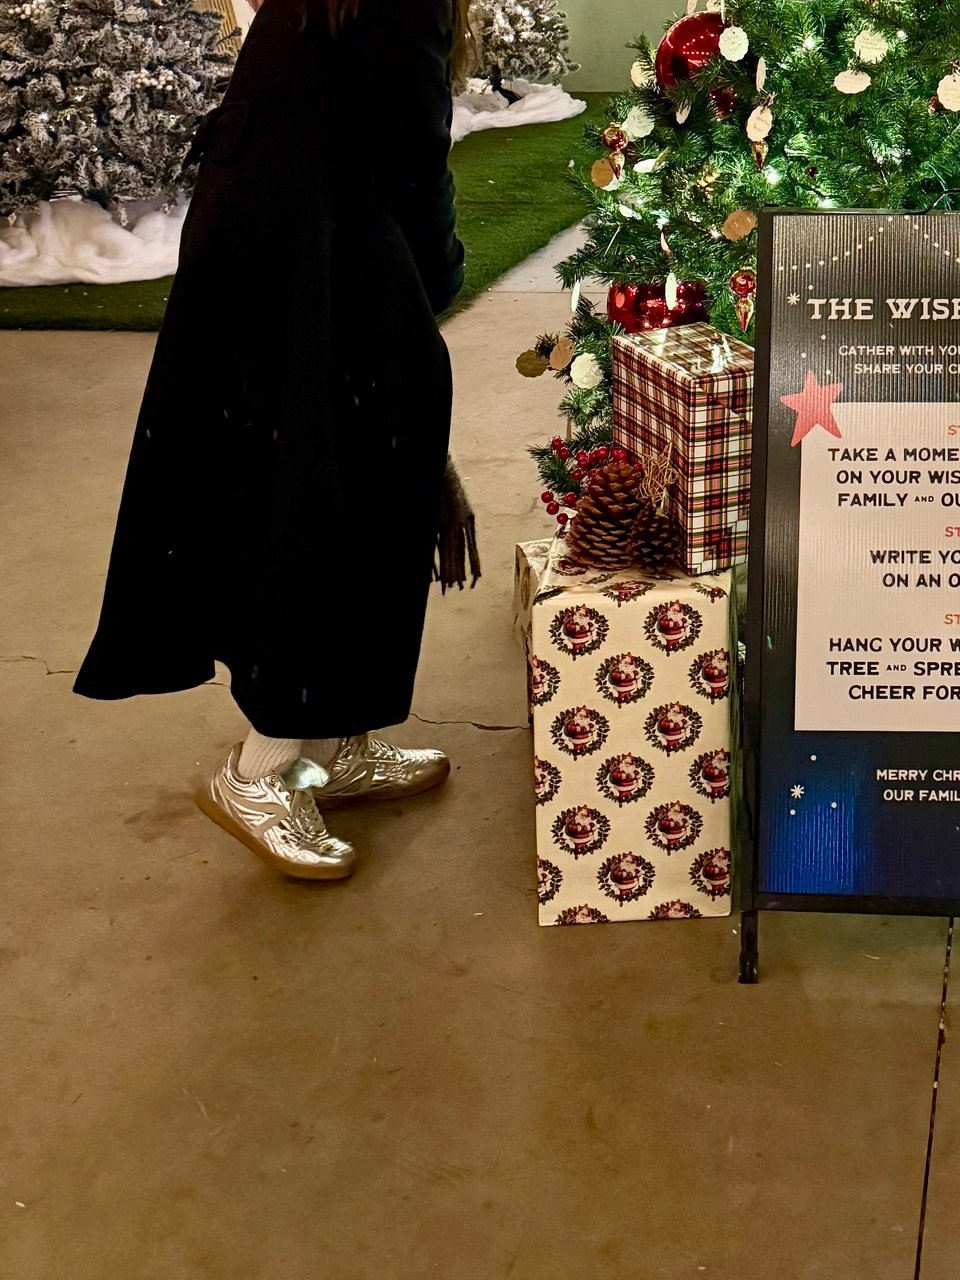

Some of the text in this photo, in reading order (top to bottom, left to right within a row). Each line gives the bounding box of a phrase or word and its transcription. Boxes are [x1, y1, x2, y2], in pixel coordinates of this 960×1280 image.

[806, 298, 874, 320] THE
[838, 345, 895, 356] GATHER
[899, 345, 934, 356] WITH
[854, 363, 901, 375] SHARE
[905, 363, 943, 375] YOUR
[828, 448, 878, 461] TAKE
[884, 448, 897, 461] A
[836, 470, 862, 484] ON
[869, 470, 921, 484] YOUR
[838, 493, 908, 507] FAMILY
[914, 495, 934, 503] AND
[870, 550, 932, 564] WRITE
[882, 573, 909, 588] ON
[915, 573, 941, 588] AN
[829, 637, 883, 652] HANG
[888, 637, 942, 653] YOUR
[826, 661, 880, 675] TREE
[886, 664, 907, 672] AND
[848, 684, 916, 700] CHEER
[876, 769, 928, 781] MERRY
[883, 789, 914, 801] OUR
